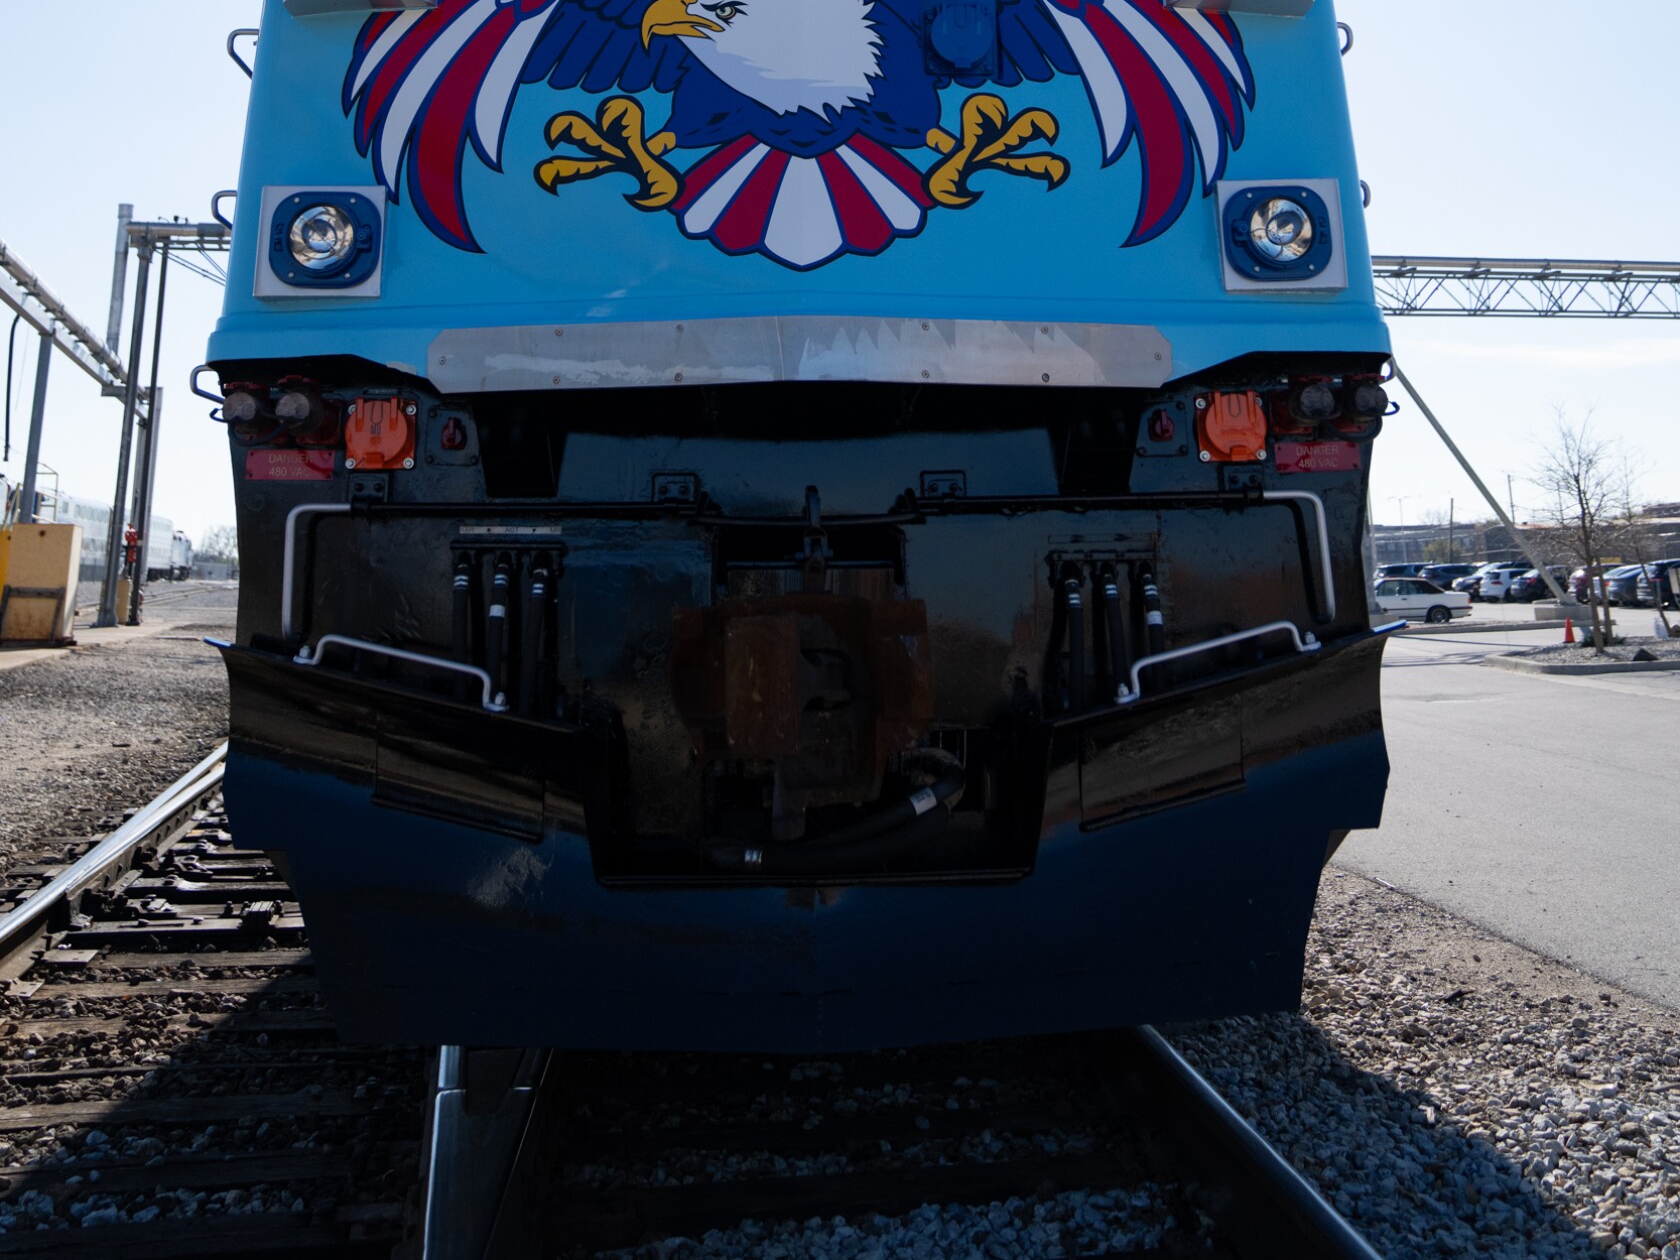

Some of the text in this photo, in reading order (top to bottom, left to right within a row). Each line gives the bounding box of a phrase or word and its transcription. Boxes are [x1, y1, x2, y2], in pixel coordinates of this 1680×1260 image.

[1295, 444, 1339, 456] DANGER
[1298, 458, 1339, 469] 480 VAC
[268, 466, 312, 477] 480 VAC
